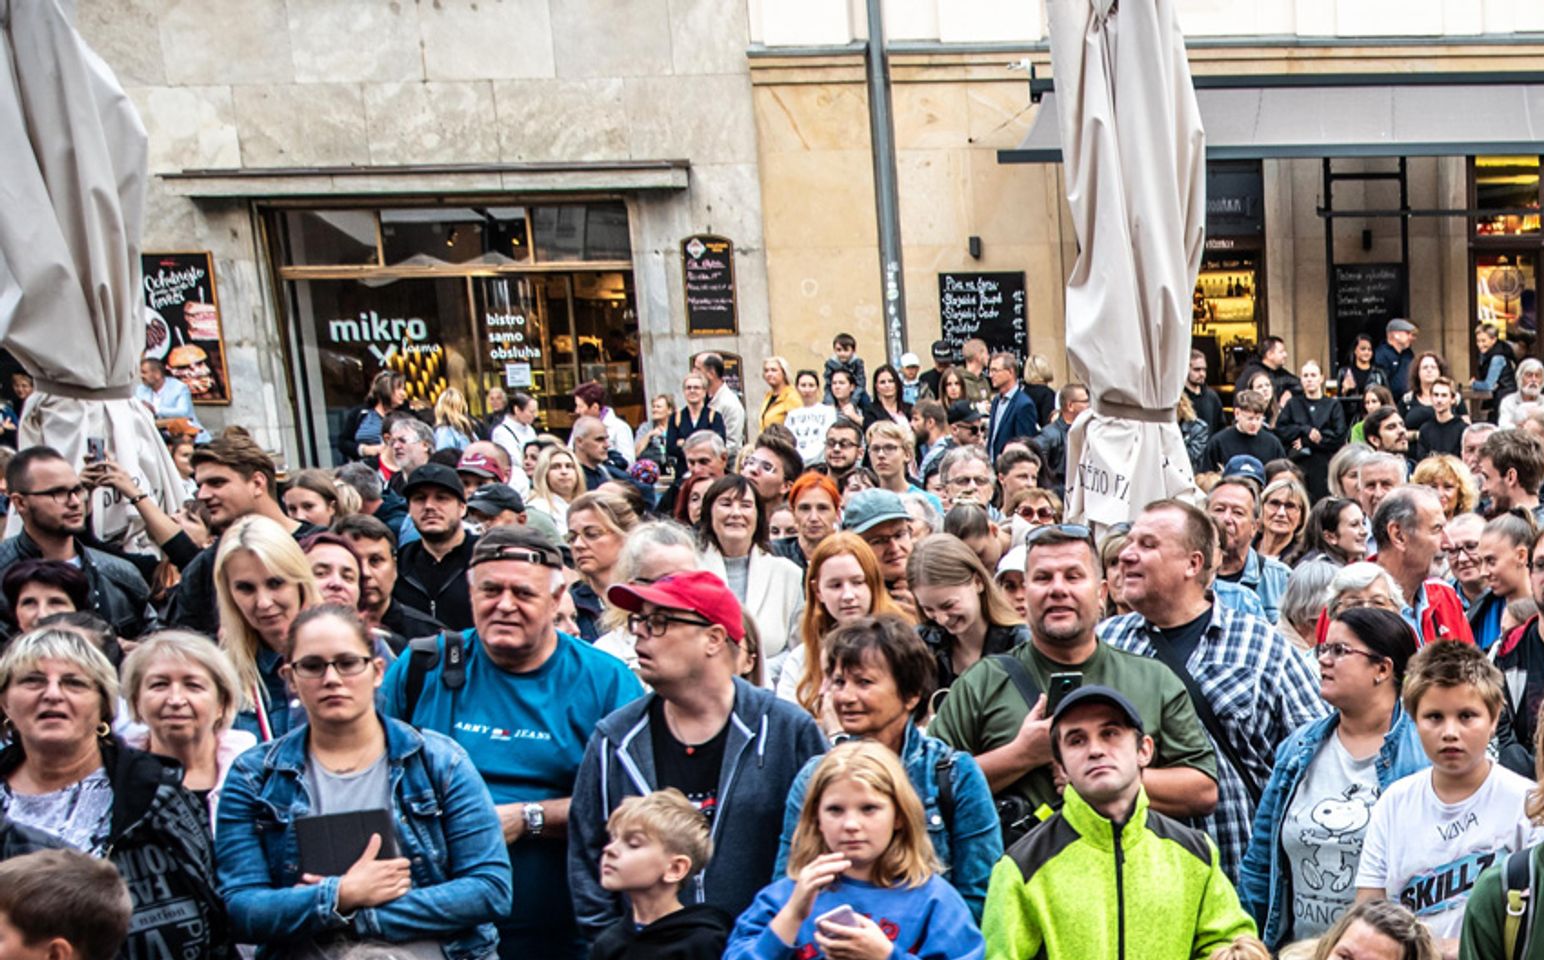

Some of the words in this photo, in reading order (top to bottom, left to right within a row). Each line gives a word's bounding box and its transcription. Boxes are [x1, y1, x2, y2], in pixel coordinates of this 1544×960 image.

[486, 312, 525, 326] bistro
[329, 310, 428, 343] mikro
[488, 331, 523, 343] samo
[490, 345, 541, 360] obsluha
